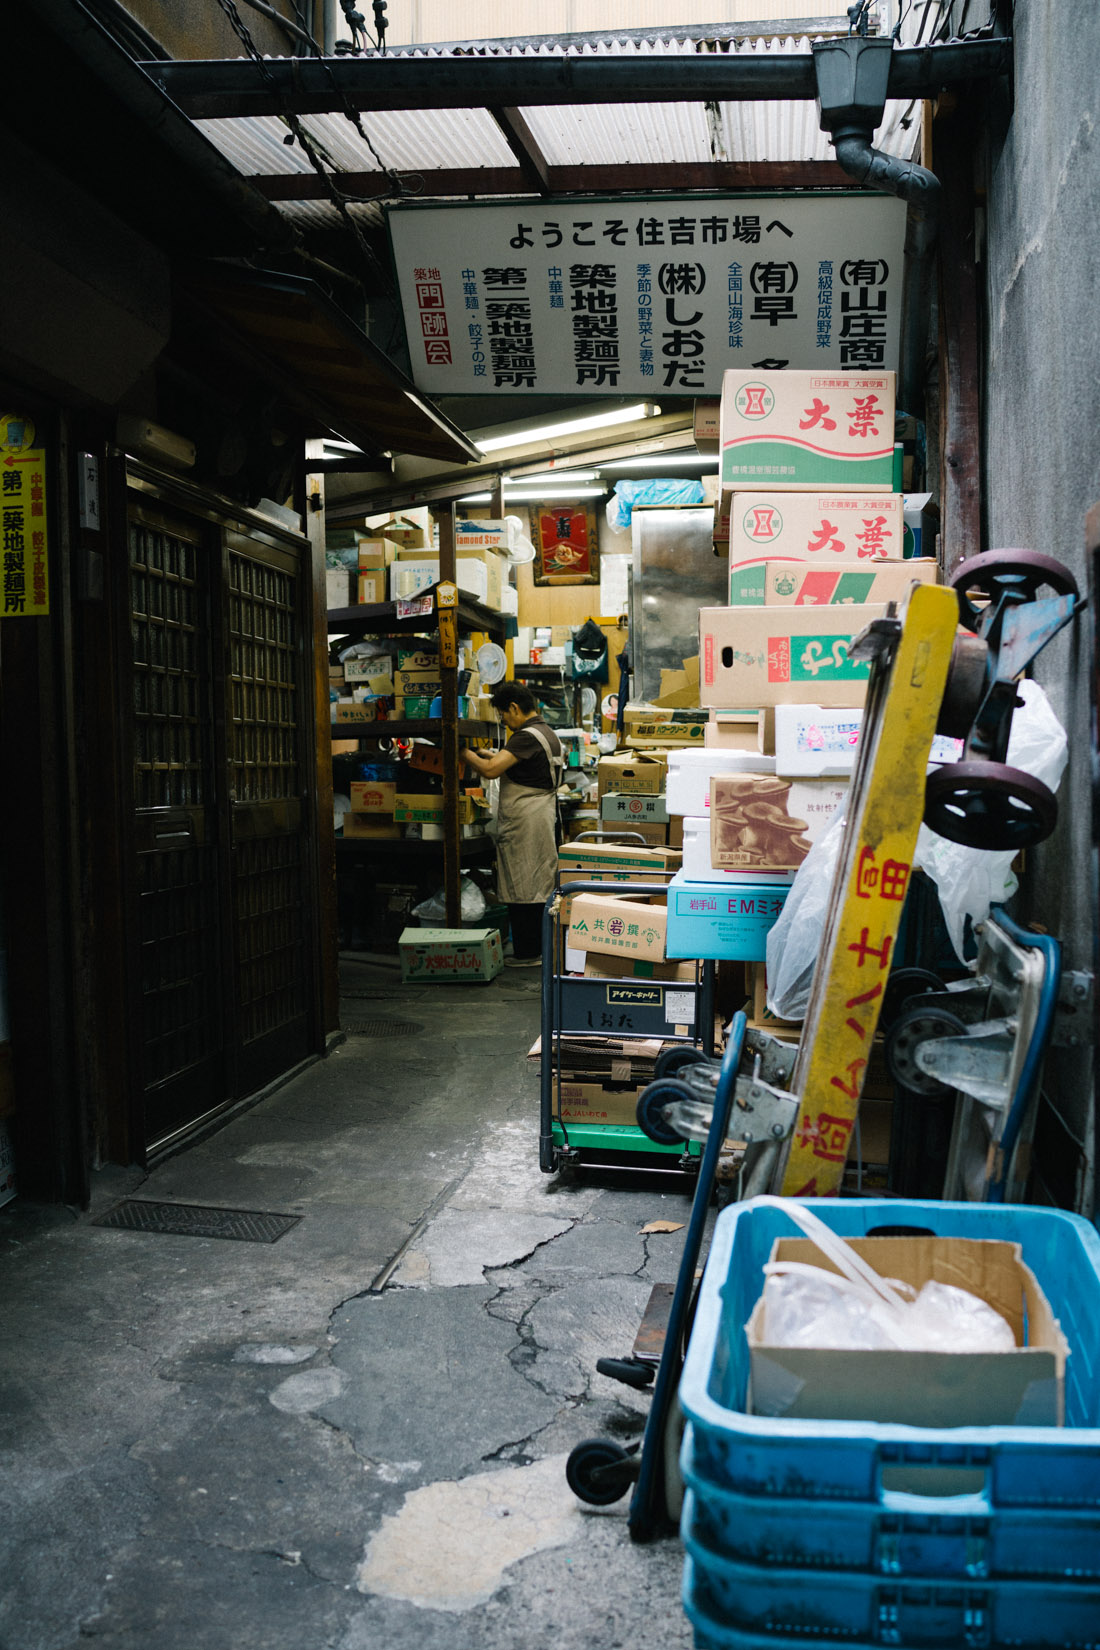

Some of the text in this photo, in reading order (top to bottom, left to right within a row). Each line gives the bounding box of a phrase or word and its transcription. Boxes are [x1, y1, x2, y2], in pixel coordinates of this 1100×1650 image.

[413, 268, 441, 281] 築地
[509, 215, 794, 249] ようこそ住吉市場へ
[417, 284, 452, 364] 門跡会
[481, 267, 537, 388] 第二築地製麺所
[548, 266, 564, 308] 中華麺
[569, 264, 621, 387] 築地製麺所
[636, 263, 654, 377] 季節の野菜と妻物
[658, 263, 706, 388] (株)しおだ
[727, 261, 743, 348] 全国山海珍味
[816, 260, 834, 348] 高級促成野菜
[798, 394, 884, 438] 大葉
[2, 470, 26, 613] 第二築地製麺所
